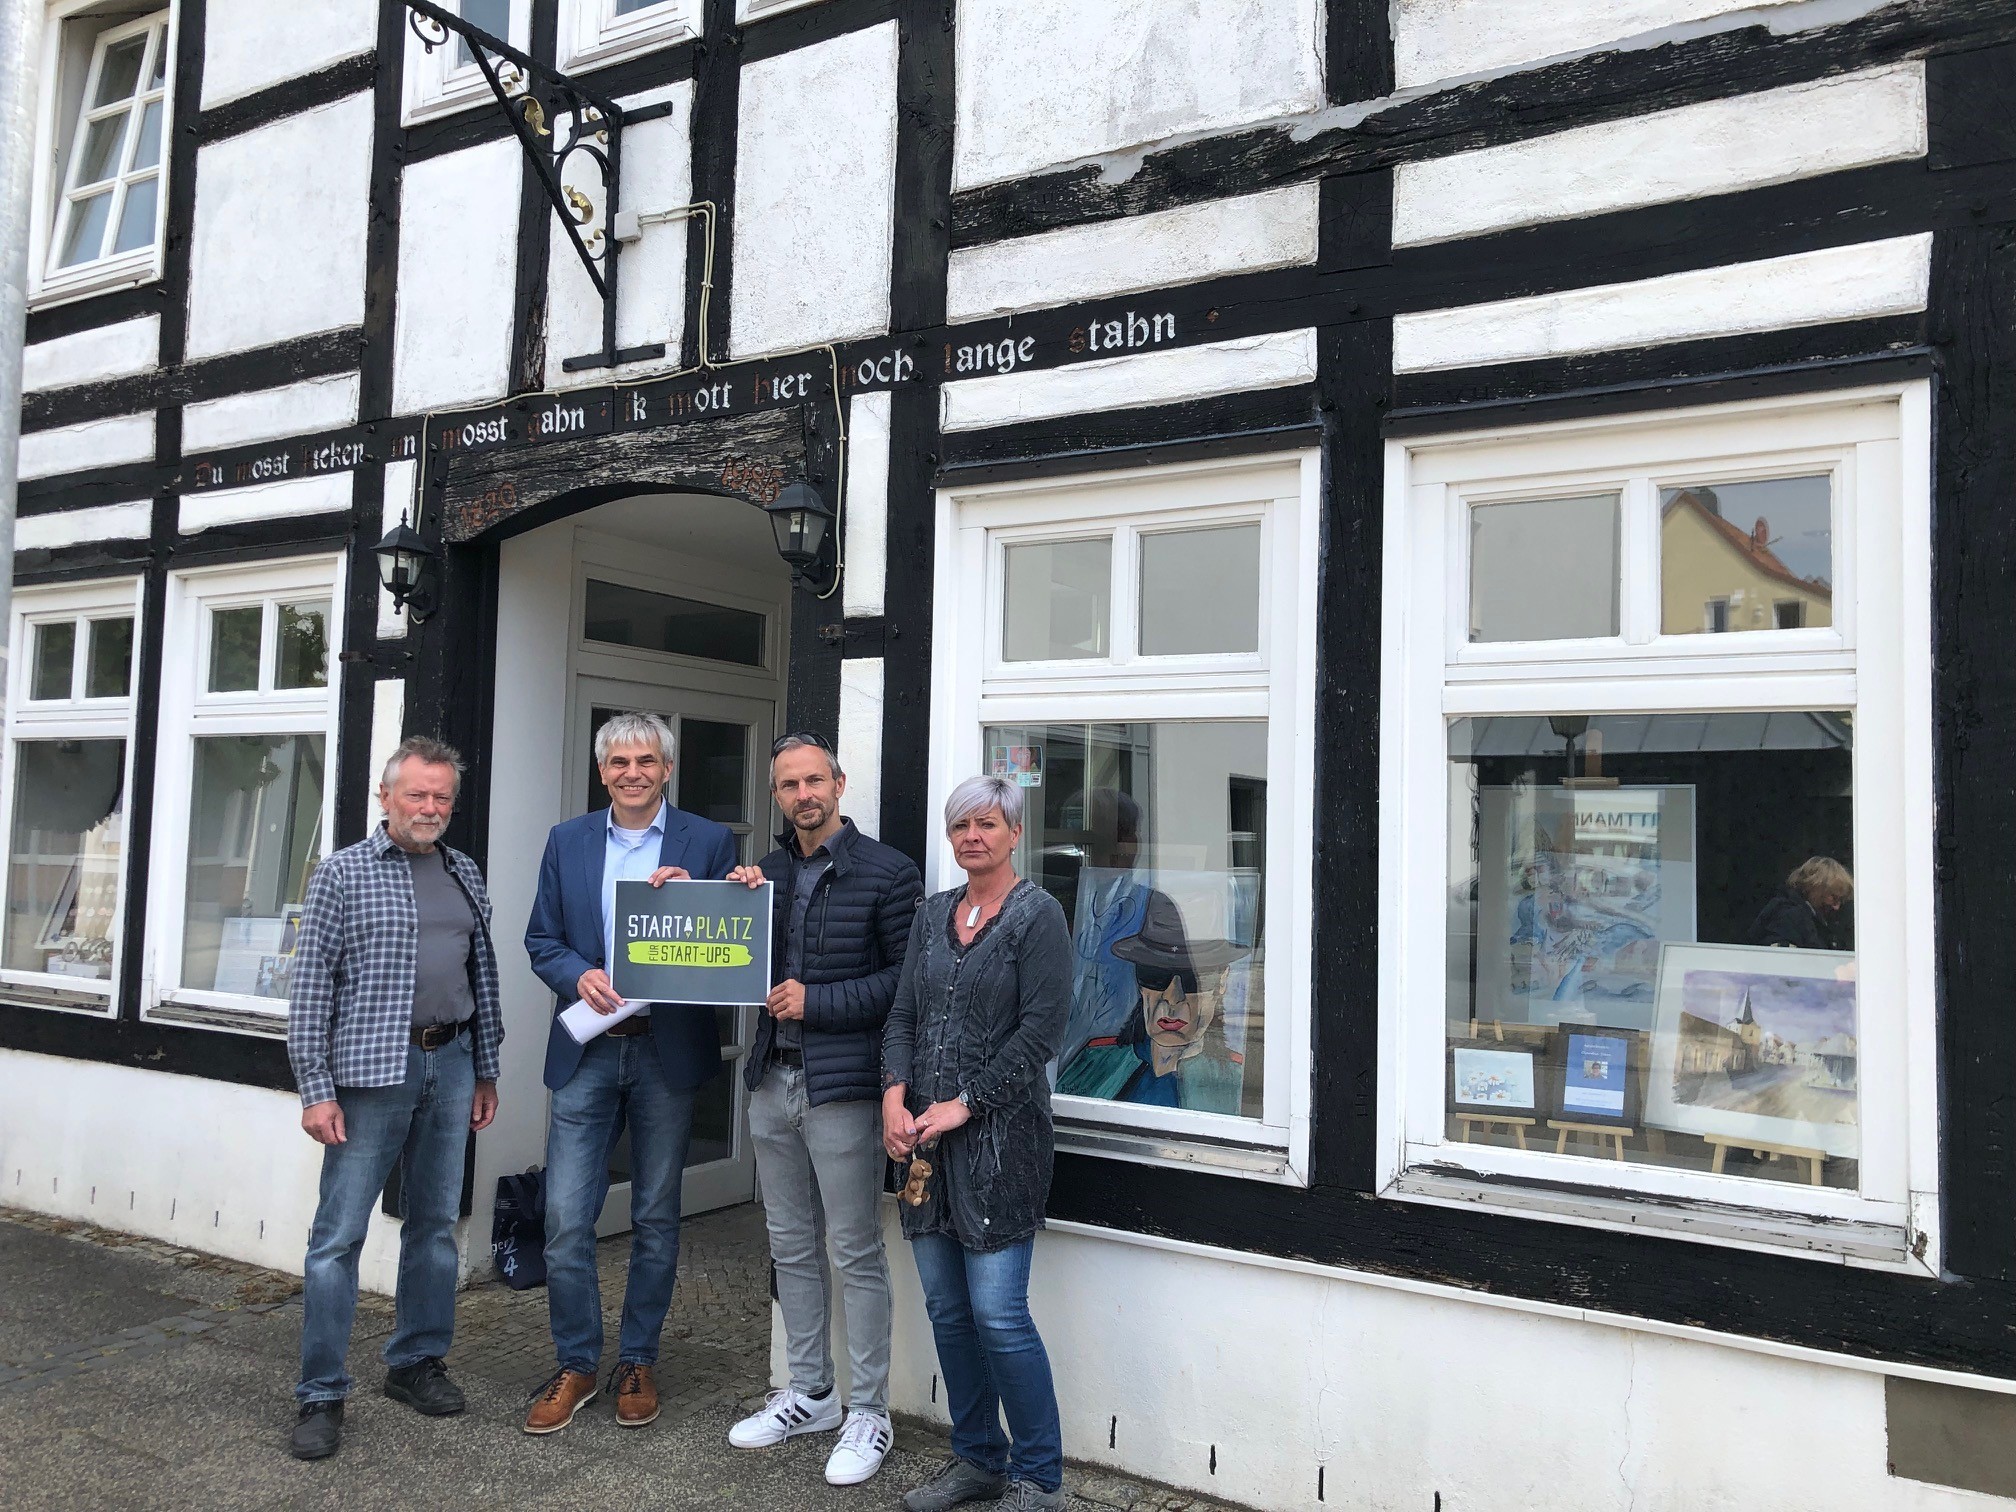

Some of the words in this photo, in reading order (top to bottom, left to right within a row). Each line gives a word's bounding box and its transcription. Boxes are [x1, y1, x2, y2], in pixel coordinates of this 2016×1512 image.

[442, 415, 508, 450] mosst
[668, 380, 733, 416] mott
[753, 370, 813, 405] hier
[841, 348, 914, 390] noch
[944, 335, 1036, 374] lange
[661, 945, 731, 964] START-UPS
[503, 1255, 519, 1277] 4
